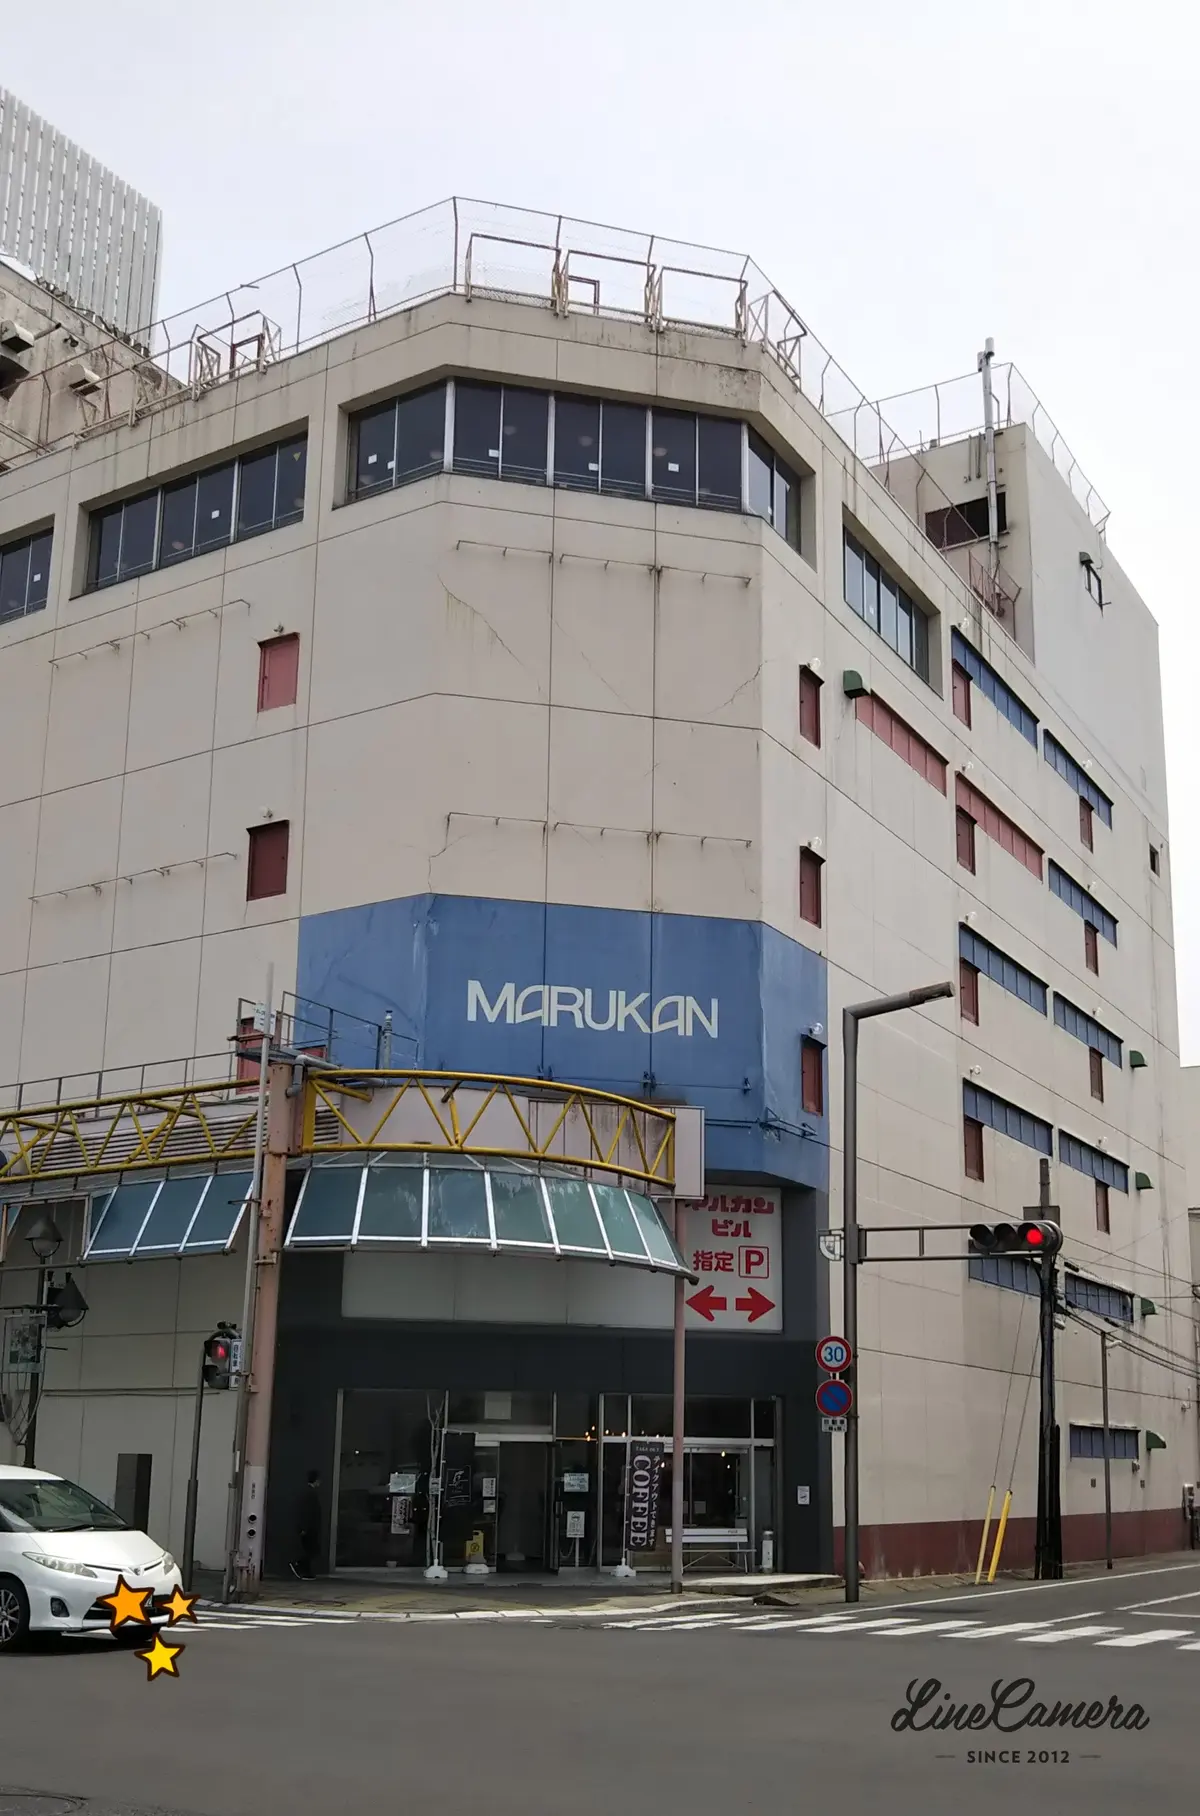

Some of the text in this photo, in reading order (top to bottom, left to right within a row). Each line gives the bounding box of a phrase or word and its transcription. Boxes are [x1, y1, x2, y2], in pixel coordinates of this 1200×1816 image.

[467, 980, 719, 1039] MARUKAN
[711, 1219, 752, 1238] ビル
[693, 1250, 764, 1274] 指定 P
[823, 1346, 844, 1363] 30
[630, 1454, 652, 1547] COFFEE
